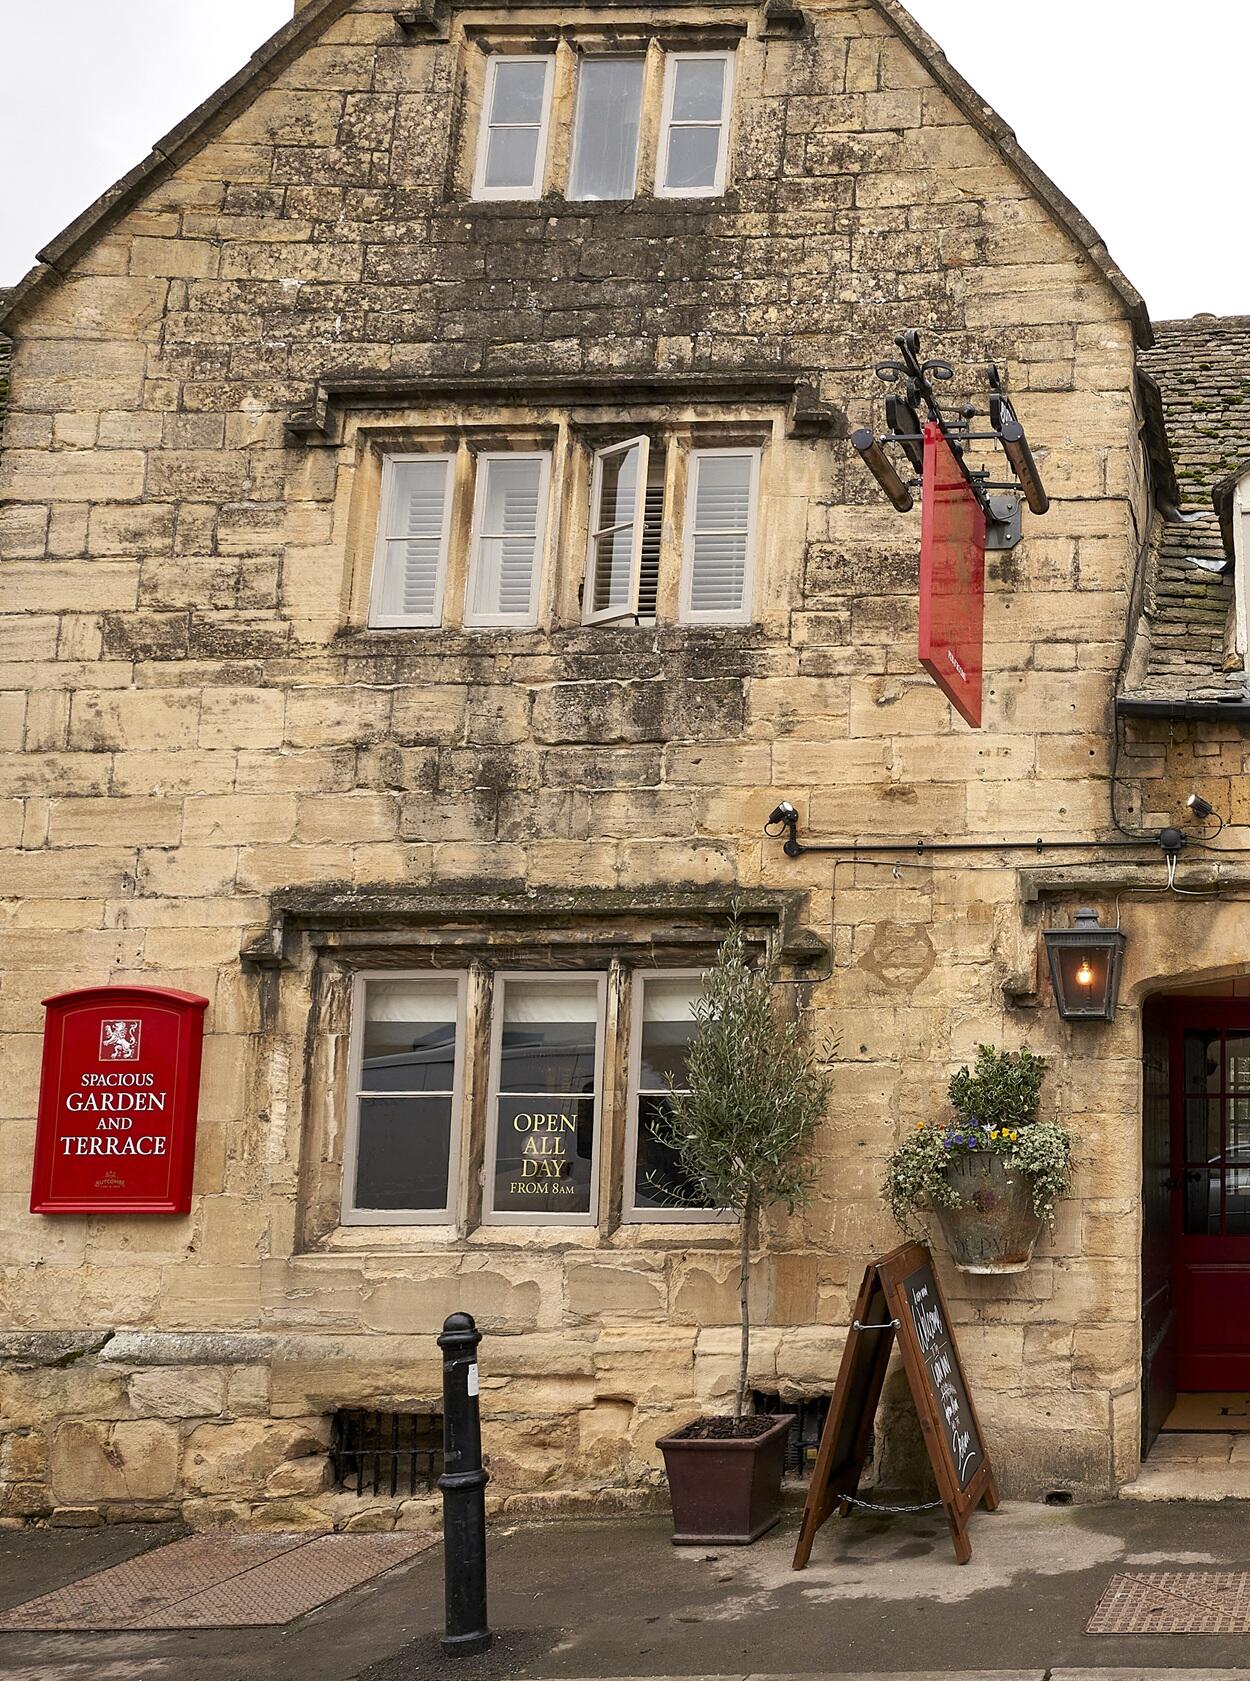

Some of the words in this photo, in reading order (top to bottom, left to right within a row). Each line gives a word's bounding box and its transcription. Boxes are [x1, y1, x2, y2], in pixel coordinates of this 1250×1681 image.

[81, 1073, 154, 1087] SPACIOUS
[66, 1092, 167, 1112] GARDEN
[96, 1117, 133, 1130] AND
[513, 1113, 578, 1132] OPEN
[60, 1136, 166, 1155] TERRACE
[522, 1136, 566, 1155] ALL
[521, 1159, 566, 1177] DAY
[510, 1182, 549, 1194] FROM
